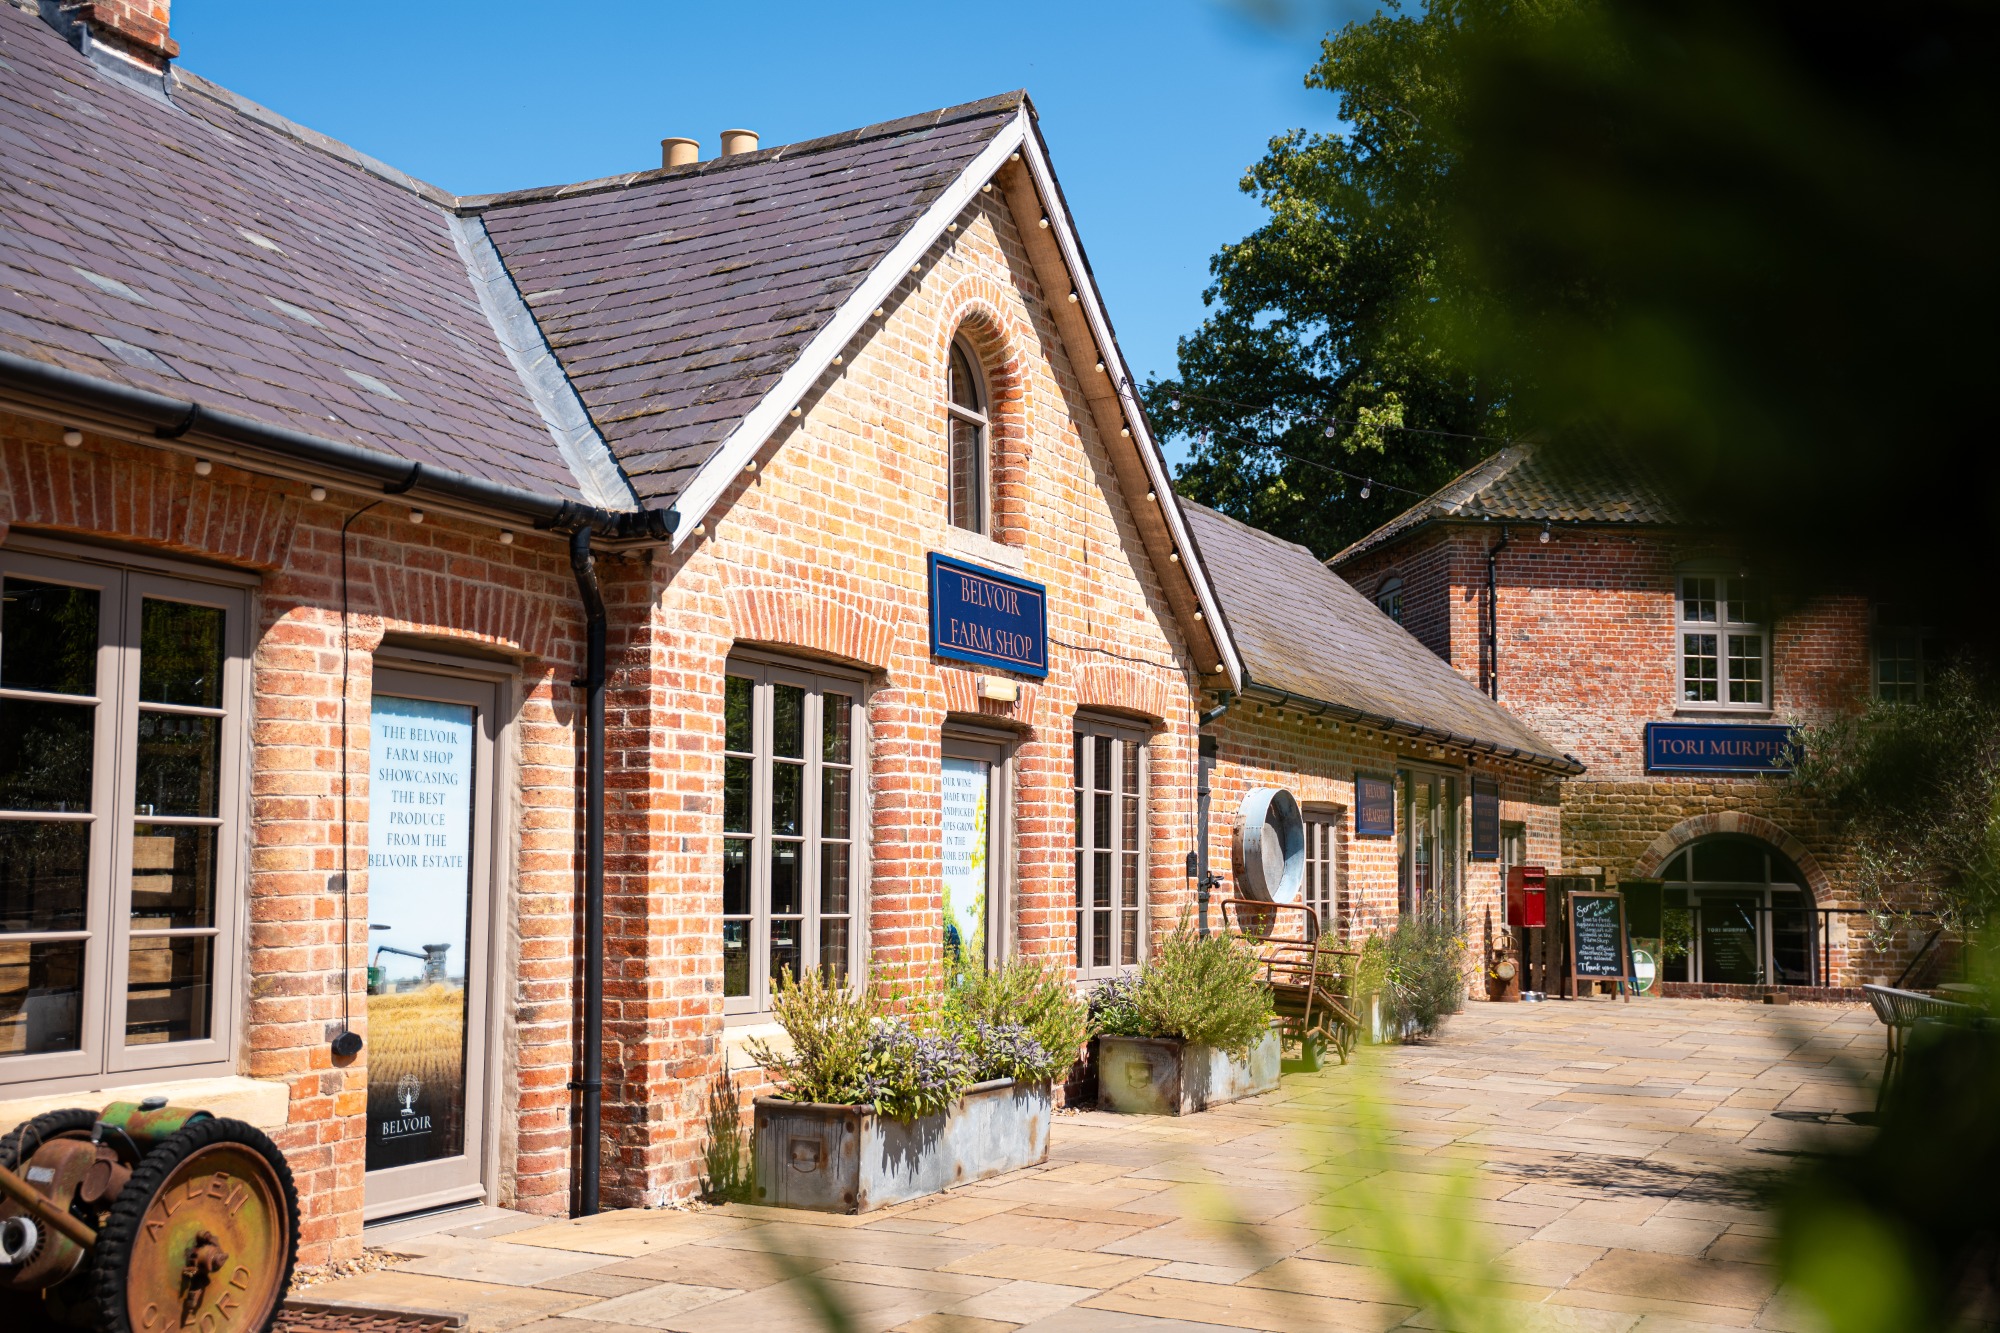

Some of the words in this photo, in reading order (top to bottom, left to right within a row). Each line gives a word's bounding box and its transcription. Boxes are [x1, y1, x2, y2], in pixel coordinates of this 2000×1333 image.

[960, 577, 1021, 616] BELVOIR
[951, 618, 993, 651] FARM
[995, 629, 1033, 660] SHOP
[382, 725, 406, 740] THE
[410, 727, 458, 744] BELVOIR
[1658, 739, 1705, 755] TORI
[386, 747, 419, 762] FARM
[423, 750, 454, 764] SHOP
[378, 768, 459, 786] SHOWCASING
[942, 777, 956, 787] OUR
[956, 778, 972, 788] WINE
[391, 790, 415, 804] THE
[419, 792, 446, 806] BEST
[943, 792, 960, 802] MADE
[961, 793, 977, 803] WITH
[390, 811, 446, 826] PRODUCE
[942, 806, 975, 818] ANDPICKED
[942, 821, 956, 831] APES
[387, 832, 420, 846] FROM
[424, 833, 447, 847] THE
[946, 836, 953, 846] IN
[954, 836, 966, 846] THE
[368, 853, 418, 868] BELVOIR
[422, 855, 463, 868] ESTATE
[942, 851, 957, 861] VOIR
[1576, 900, 1600, 917] Sorry
[1578, 961, 1601, 972] Thank
[1601, 965, 1617, 975] you
[382, 1115, 432, 1136] BELVOIR
[145, 1171, 249, 1243] ALLEN
[142, 1264, 250, 1333] OXORD
